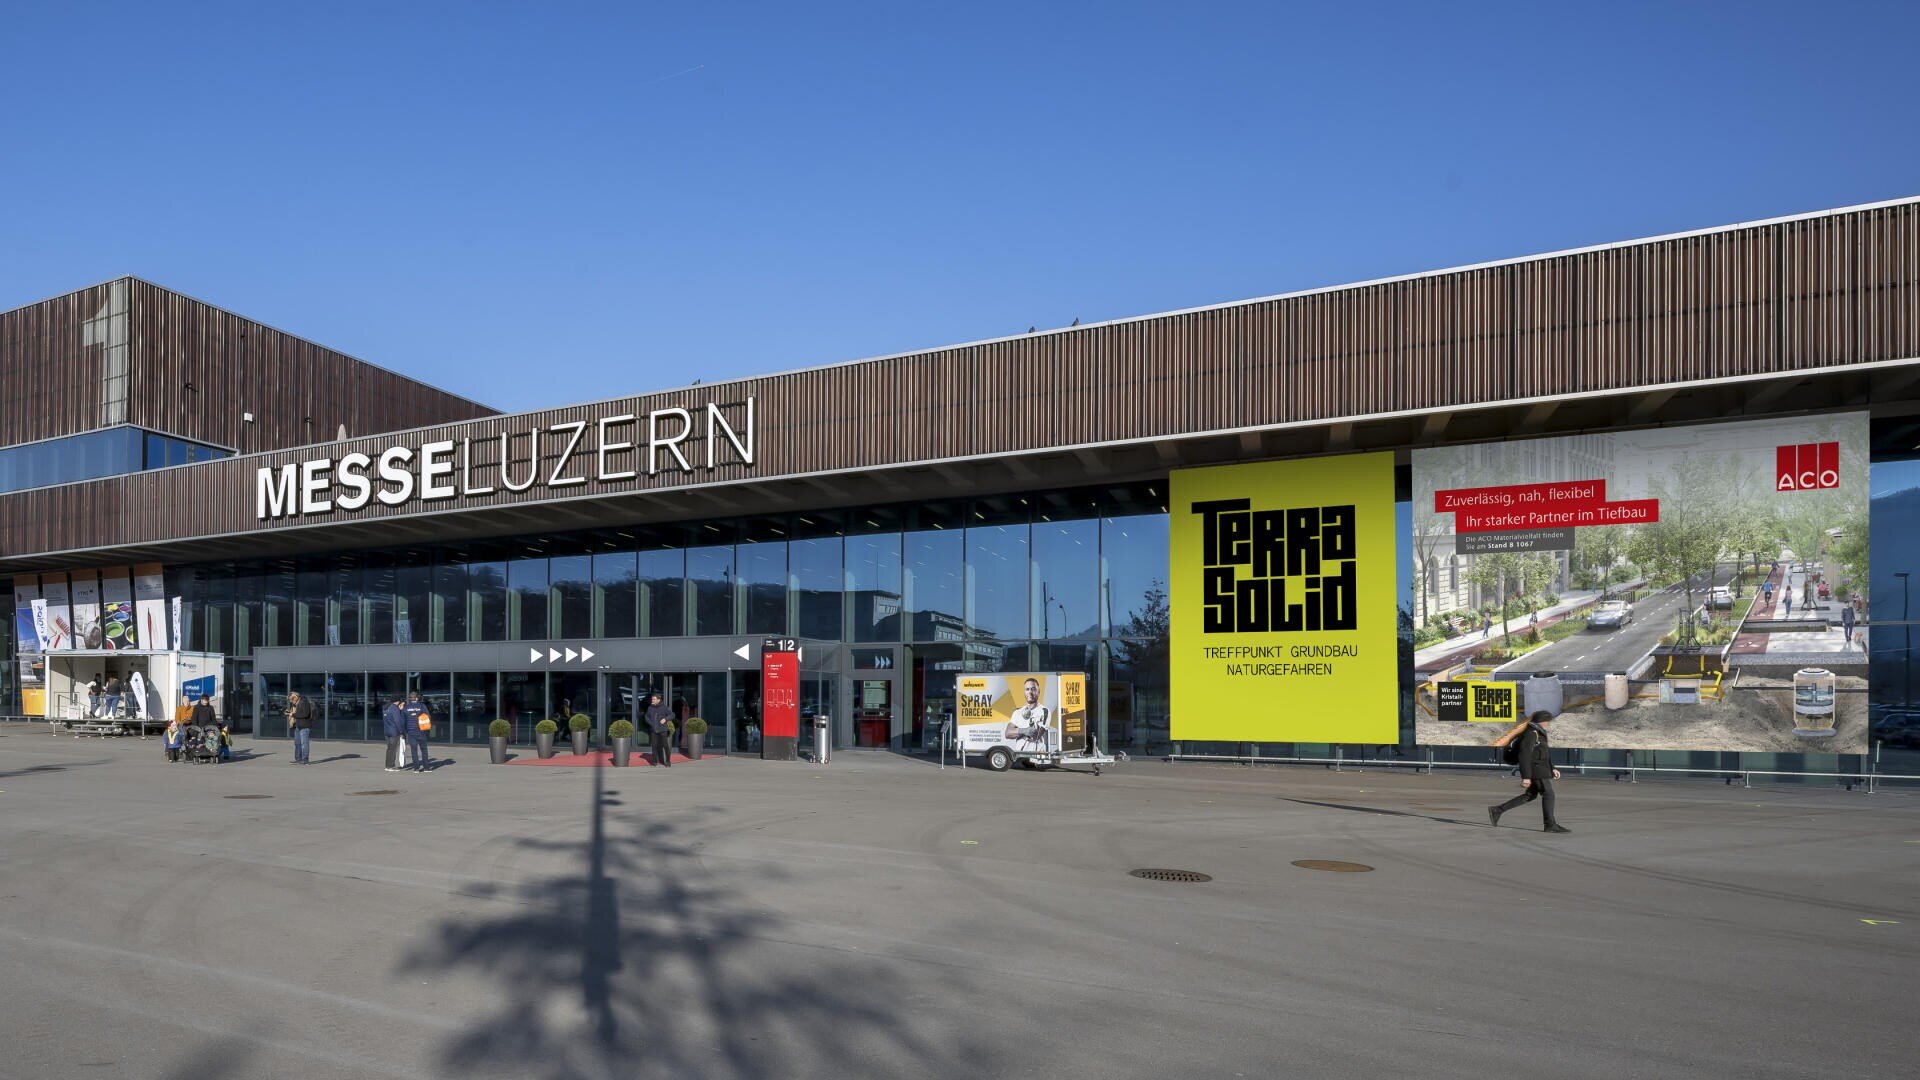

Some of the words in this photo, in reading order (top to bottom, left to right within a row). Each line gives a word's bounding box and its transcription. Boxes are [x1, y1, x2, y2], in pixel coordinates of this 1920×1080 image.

[1778, 469, 1838, 490] ACO
[1445, 492, 1515, 507] Zuverlässig,
[1519, 489, 1545, 503] nah,
[1549, 485, 1595, 499] flexibel
[1466, 515, 1483, 528] Ihr
[1485, 513, 1525, 526] starker
[1529, 511, 1575, 524] Partner
[1578, 509, 1594, 521] im
[1598, 506, 1647, 520] Tiefbau
[1543, 531, 1564, 539] finden
[1204, 646, 1283, 659] TREFFPUNKT
[1291, 645, 1358, 658] GRUNDBAU
[1227, 663, 1332, 676] NATURGEFAHREN
[1065, 681, 1081, 695] SPRAY
[961, 694, 993, 708] SPRAY
[961, 708, 980, 717] FORCE
[981, 708, 993, 717] ONE
